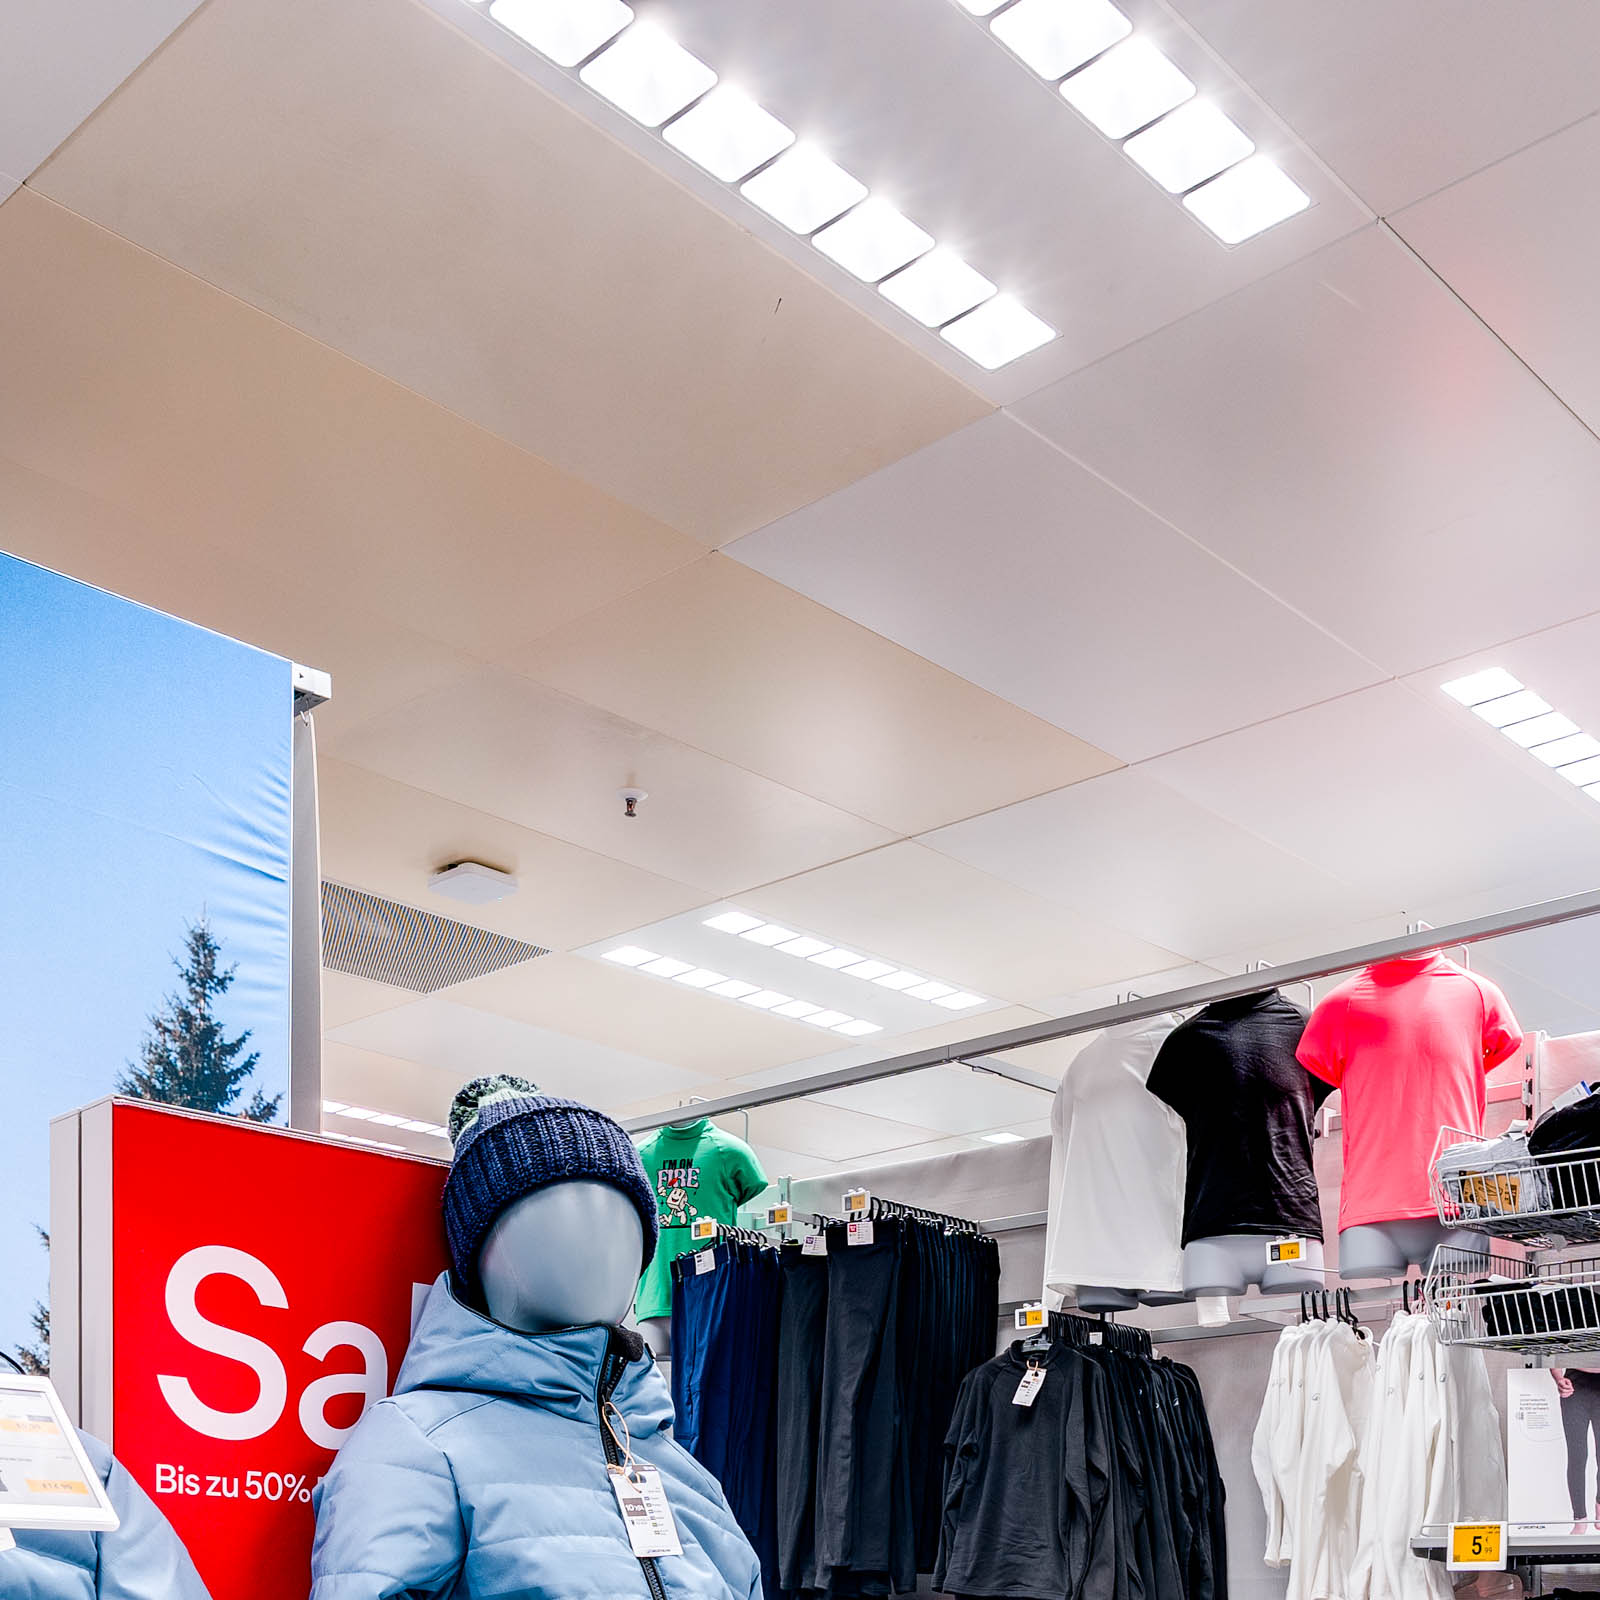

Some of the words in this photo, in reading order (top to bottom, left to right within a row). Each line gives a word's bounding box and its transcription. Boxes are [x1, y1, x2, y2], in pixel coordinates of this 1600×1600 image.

[662, 1159, 677, 1169] I'M
[679, 1158, 694, 1168] ON
[656, 1167, 700, 1189] FIRE
[155, 1463, 200, 1496] Bis
[206, 1475, 239, 1498] zu
[245, 1471, 311, 1503] 50%
[1472, 1536, 1482, 1555] 5
